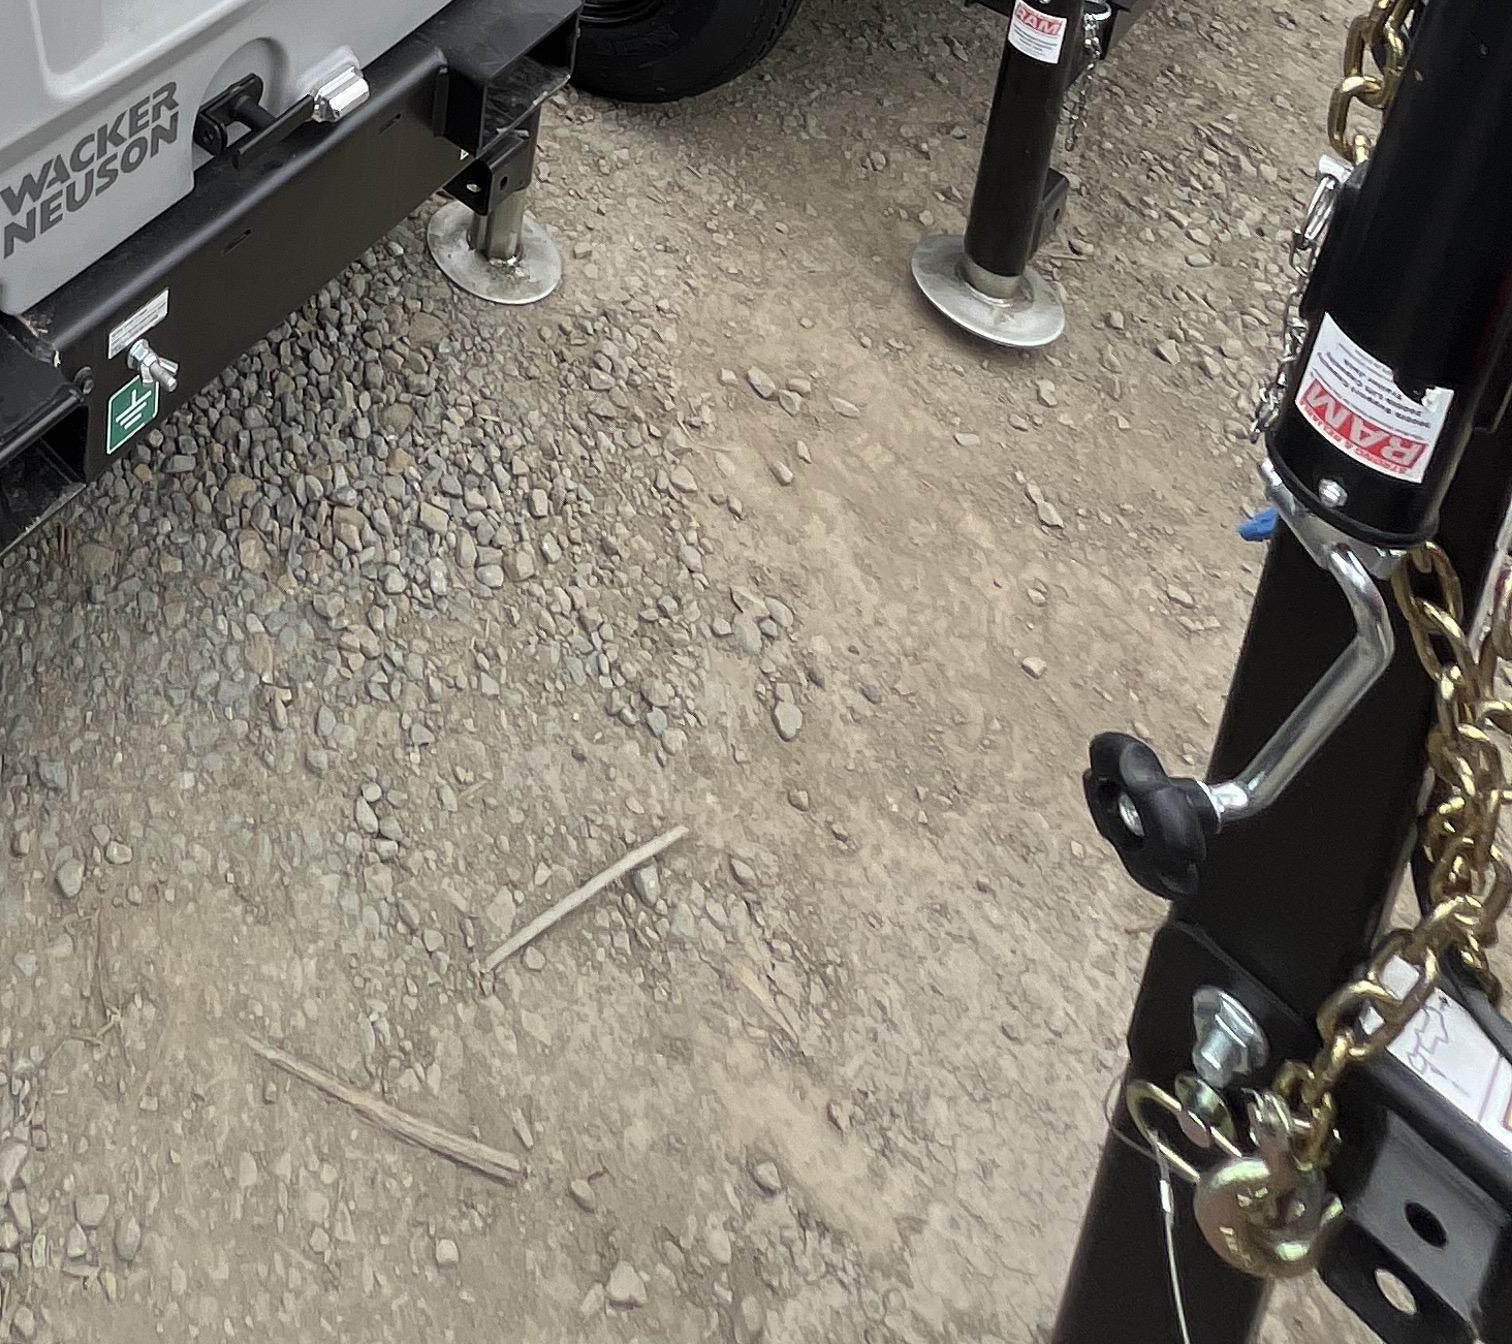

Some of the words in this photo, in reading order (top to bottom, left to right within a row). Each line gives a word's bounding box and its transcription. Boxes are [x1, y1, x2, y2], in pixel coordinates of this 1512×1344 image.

[1015, 4, 1061, 35] RAM
[0, 81, 179, 216] WACKER
[4, 111, 179, 259] NEUSON
[1305, 381, 1423, 467] RAM
